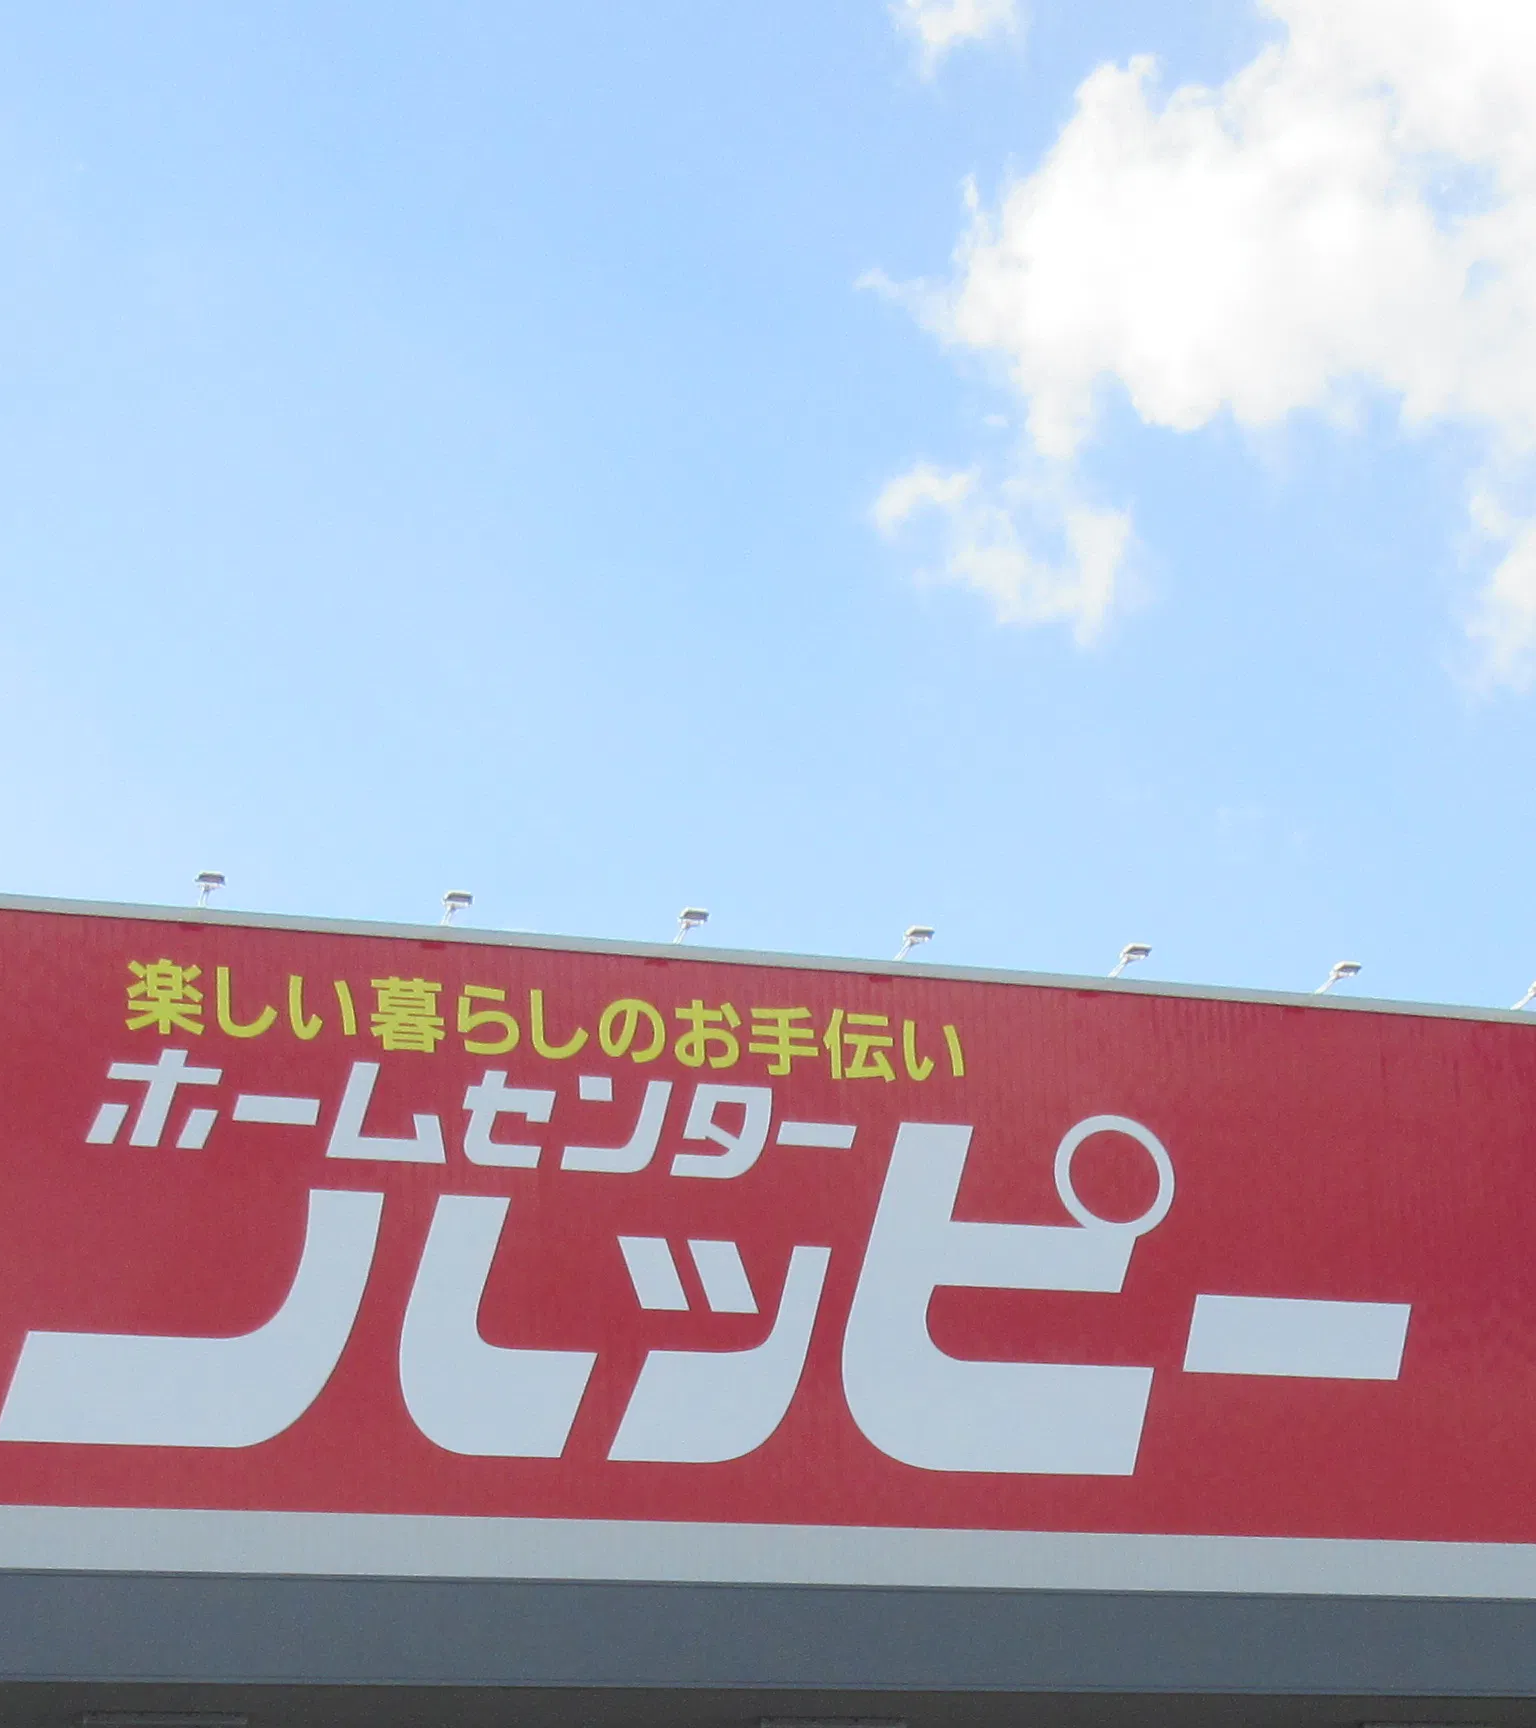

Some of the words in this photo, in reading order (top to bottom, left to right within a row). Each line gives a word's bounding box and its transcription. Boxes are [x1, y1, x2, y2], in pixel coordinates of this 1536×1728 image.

[125, 959, 966, 1082] 楽しい暮らしのお手伝い
[85, 1048, 858, 1179] ホームセンター
